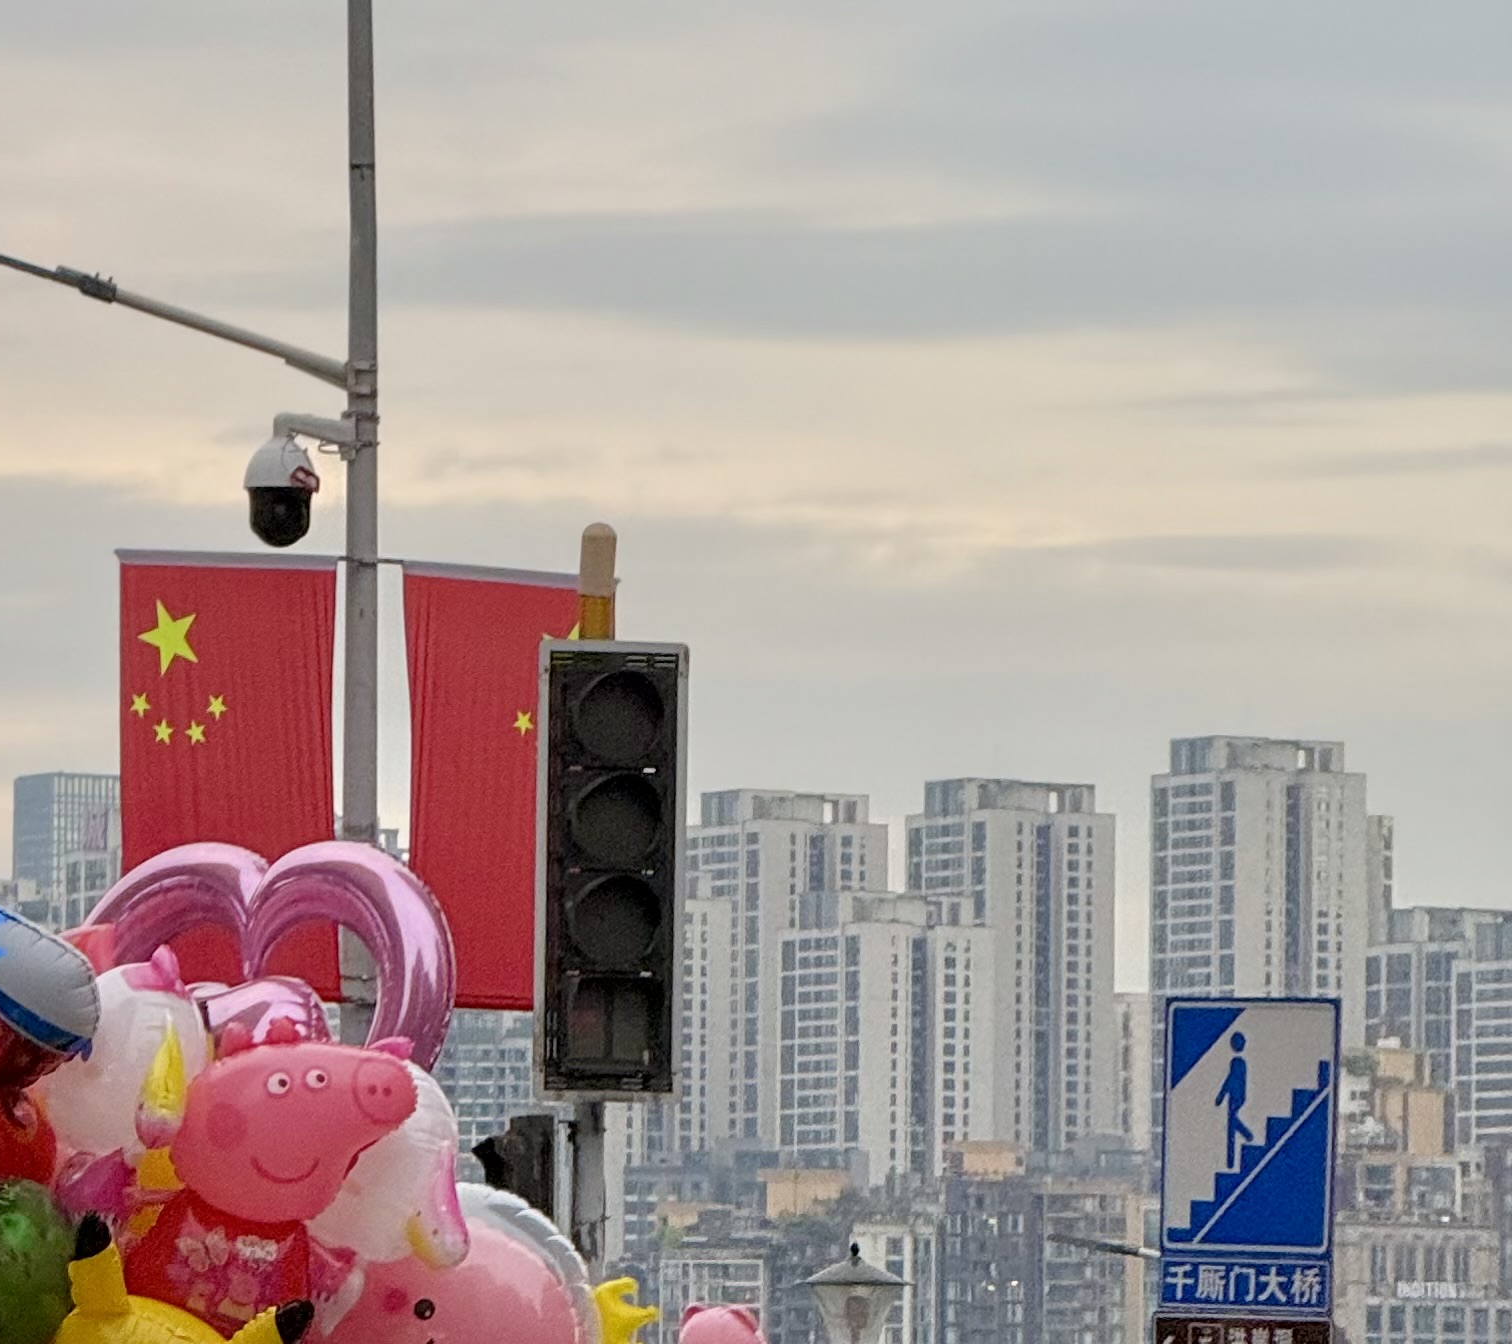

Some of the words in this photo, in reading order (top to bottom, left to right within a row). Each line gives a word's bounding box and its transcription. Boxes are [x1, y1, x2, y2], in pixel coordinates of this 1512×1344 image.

[1165, 1264, 1322, 1304] 千厮门大桥
